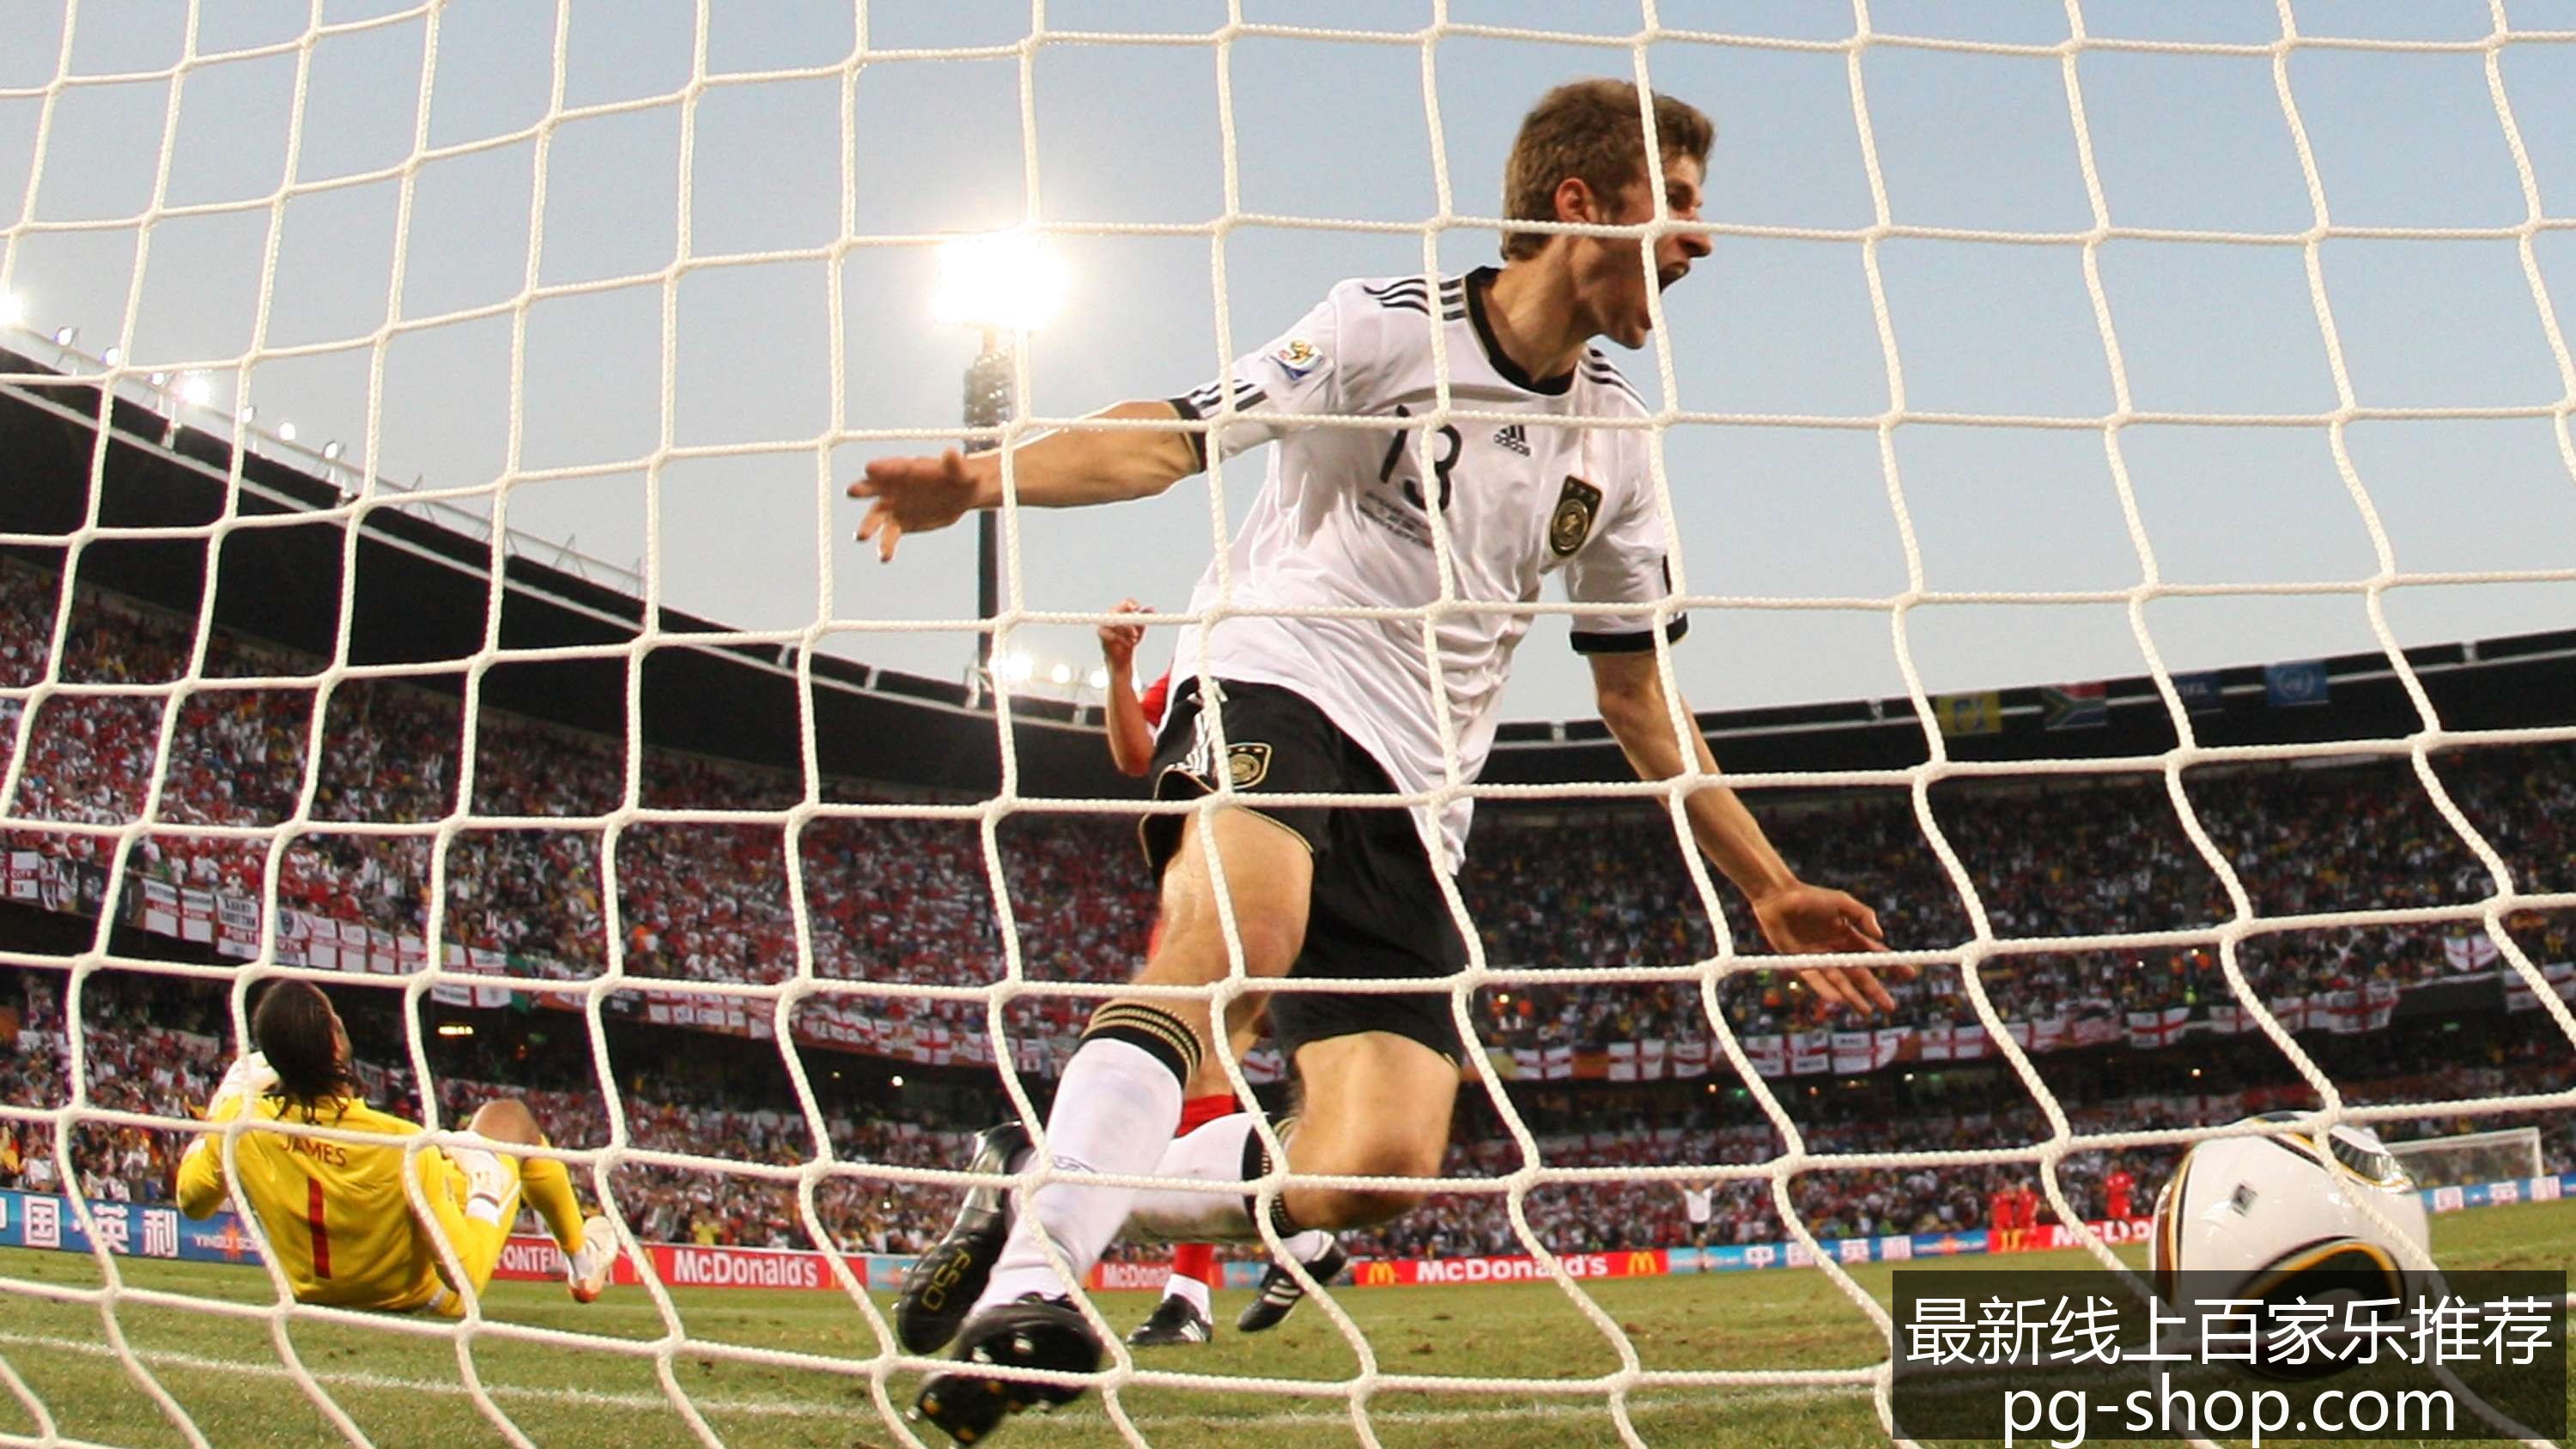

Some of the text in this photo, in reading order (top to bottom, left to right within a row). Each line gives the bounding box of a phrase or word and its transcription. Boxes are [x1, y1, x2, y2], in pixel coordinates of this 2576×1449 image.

[282, 1135, 347, 1167] JAMES
[307, 1176, 331, 1280] 1
[674, 1245, 817, 1286] McDonald's
[921, 1247, 971, 1312] F50
